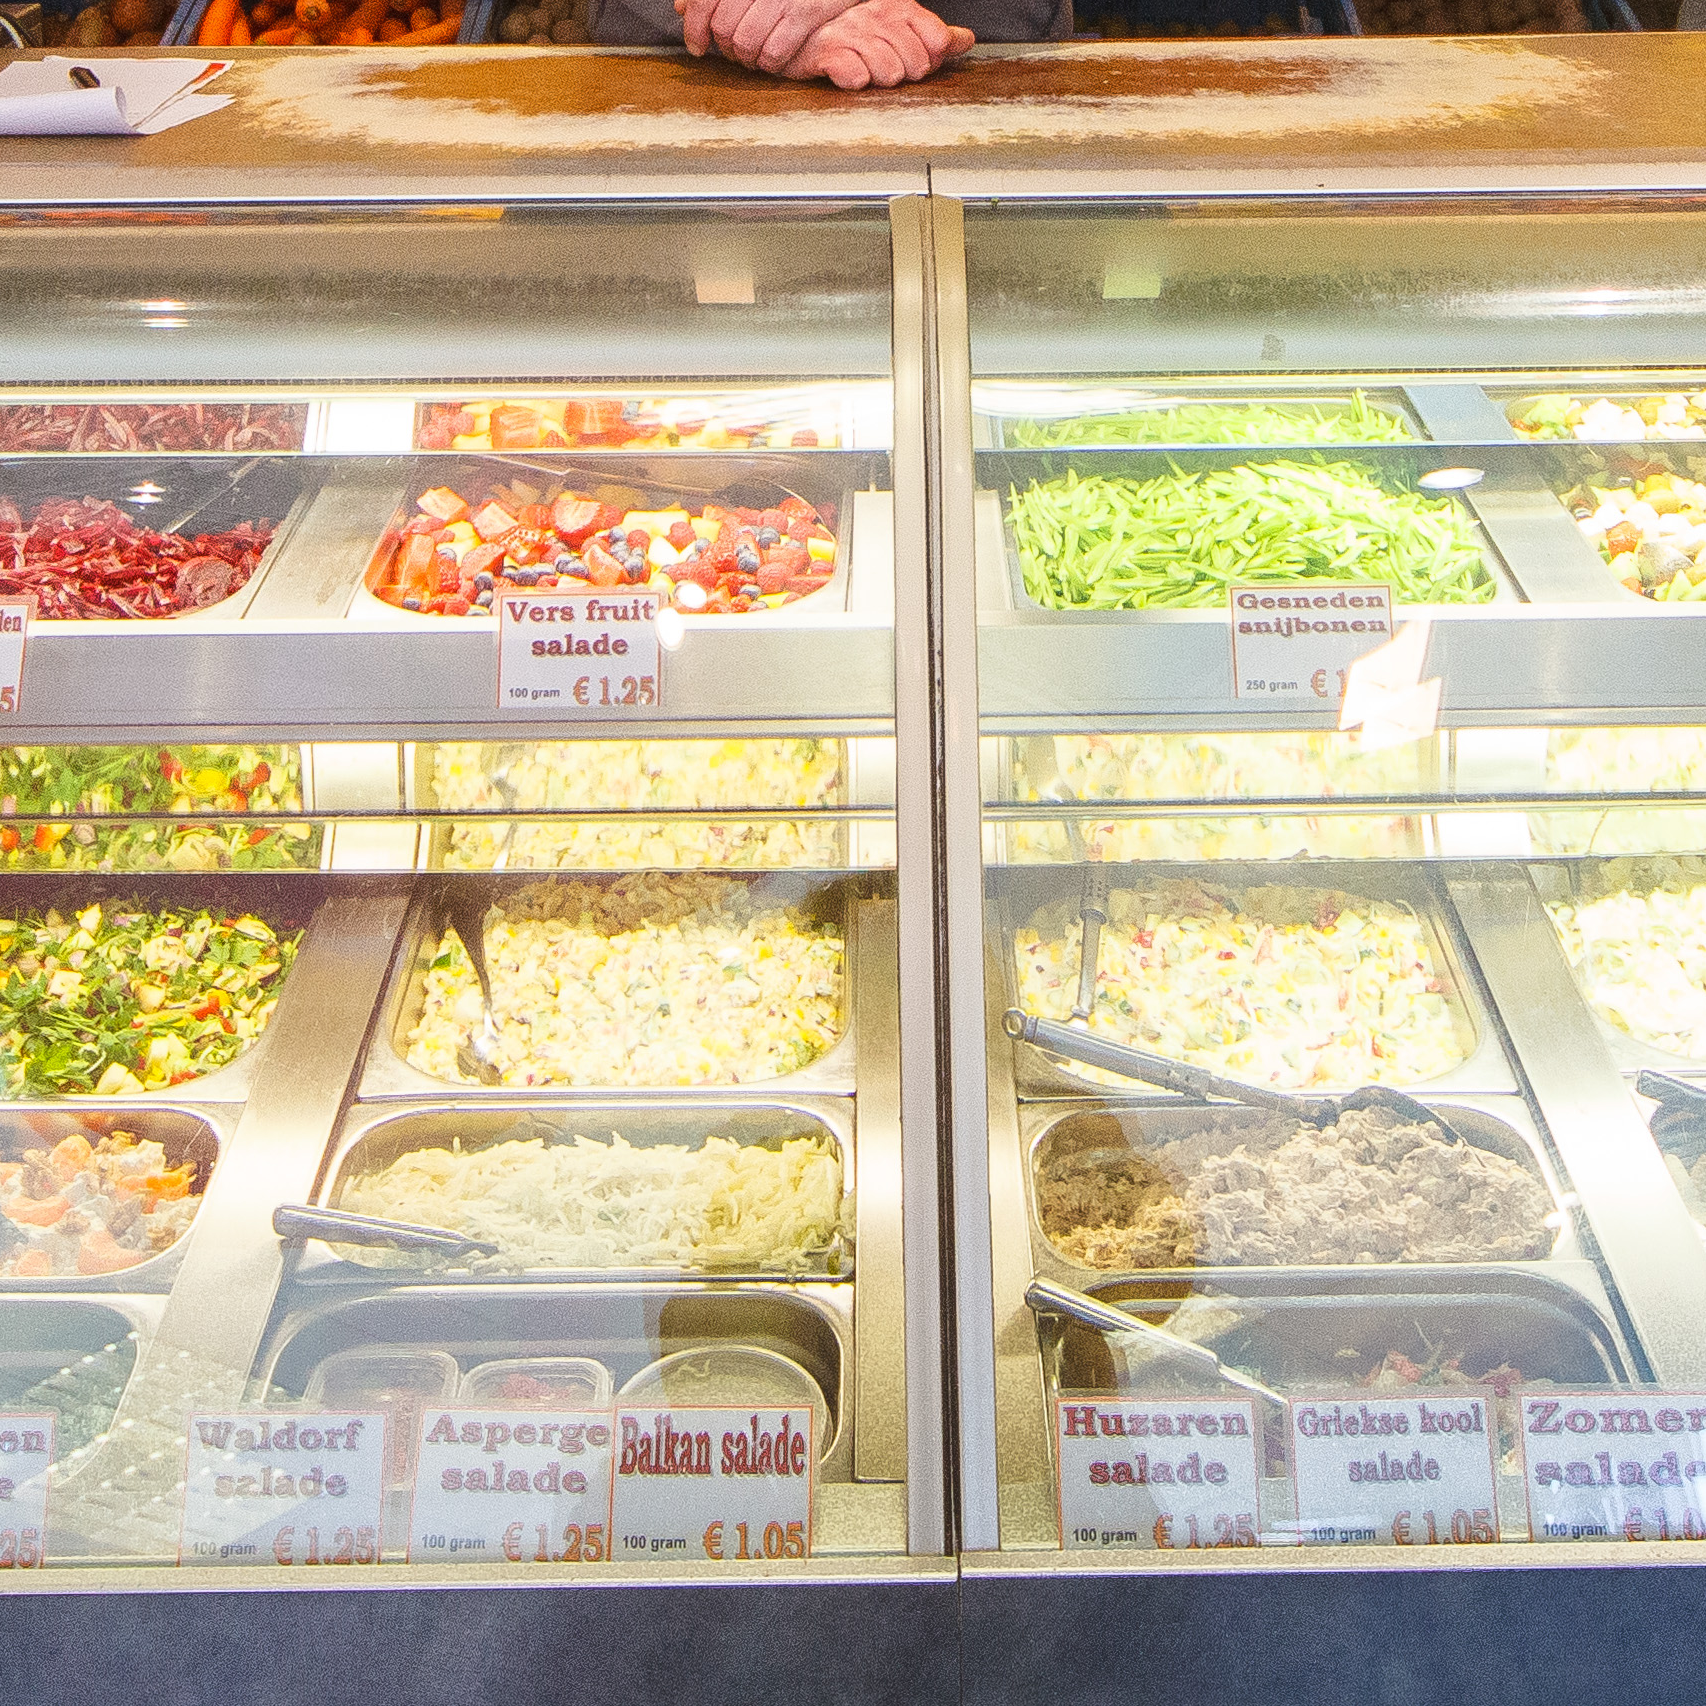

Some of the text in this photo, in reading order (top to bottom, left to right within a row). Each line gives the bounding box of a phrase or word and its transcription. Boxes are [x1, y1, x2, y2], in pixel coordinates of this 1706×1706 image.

[506, 599, 654, 623] Vers fruit
[1236, 592, 1385, 609] Gesneden
[1238, 616, 1388, 638] snijbonen
[531, 633, 629, 656] salade
[509, 688, 529, 698] 100
[531, 689, 560, 700] gram
[599, 675, 655, 705] 1.25
[1269, 681, 1298, 692] gram
[195, 1419, 365, 1450] Waldorf
[426, 1414, 609, 1453] Asperge
[1062, 1406, 1249, 1437] Huzaren
[1297, 1402, 1483, 1437] Griekse kool
[619, 1413, 804, 1475] Balkan salade
[214, 1466, 348, 1497] salade
[441, 1460, 587, 1494] salade
[1088, 1453, 1228, 1485] salade
[1348, 1451, 1440, 1482] salade
[622, 1536, 645, 1549] 100
[650, 1536, 686, 1551] gram
[736, 1520, 803, 1559] 1.05
[1184, 1514, 1256, 1549] 1.25
[1423, 1509, 1492, 1544] 1.05
[305, 1525, 375, 1565] 1.25
[534, 1523, 603, 1562] 1.25
